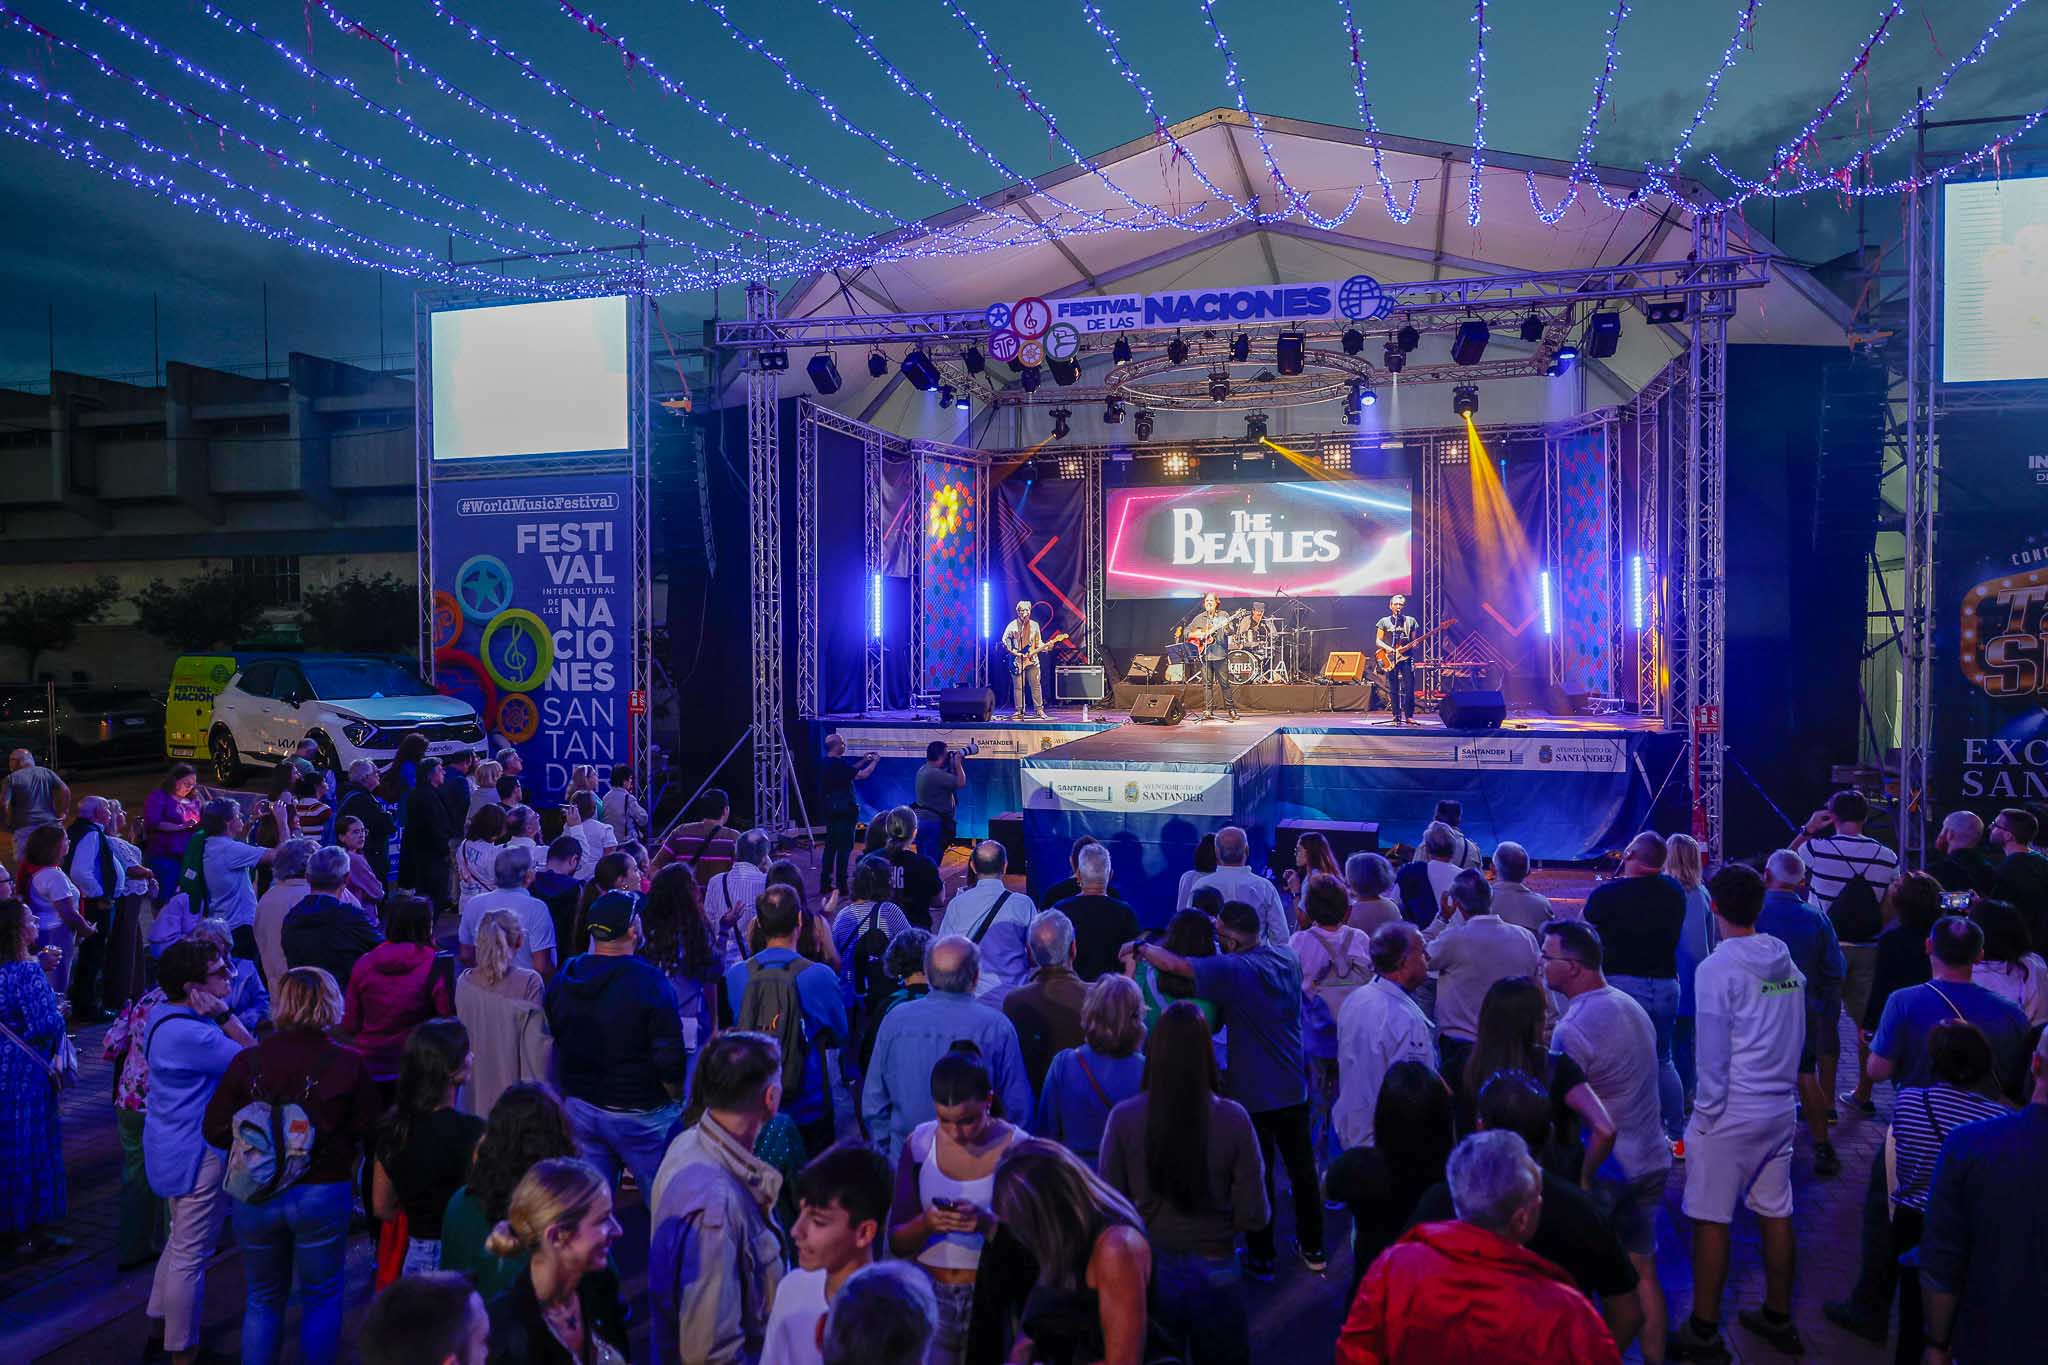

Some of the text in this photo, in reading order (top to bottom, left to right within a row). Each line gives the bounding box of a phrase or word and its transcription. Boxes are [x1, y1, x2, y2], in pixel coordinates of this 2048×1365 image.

[1058, 298, 1142, 318] FESTIVAL
[1144, 287, 1332, 324] NACIONES
[1087, 317, 1134, 330] DE LAS
[461, 495, 614, 513] #WorldMusicFestival
[1230, 510, 1273, 533] THE
[516, 522, 613, 554] FESTI
[1171, 508, 1340, 574] BEATLES
[544, 555, 615, 585] VAL
[542, 587, 615, 595] INTERCULTURAL
[561, 597, 616, 628] NA
[551, 629, 614, 660] CIO
[544, 661, 616, 692] NES
[543, 697, 614, 727] SAN
[544, 730, 615, 760] TAN
[1555, 754, 1613, 762] SANTANDER
[1057, 784, 1104, 792] SANTANDER
[1142, 791, 1204, 802] SANTANDER
